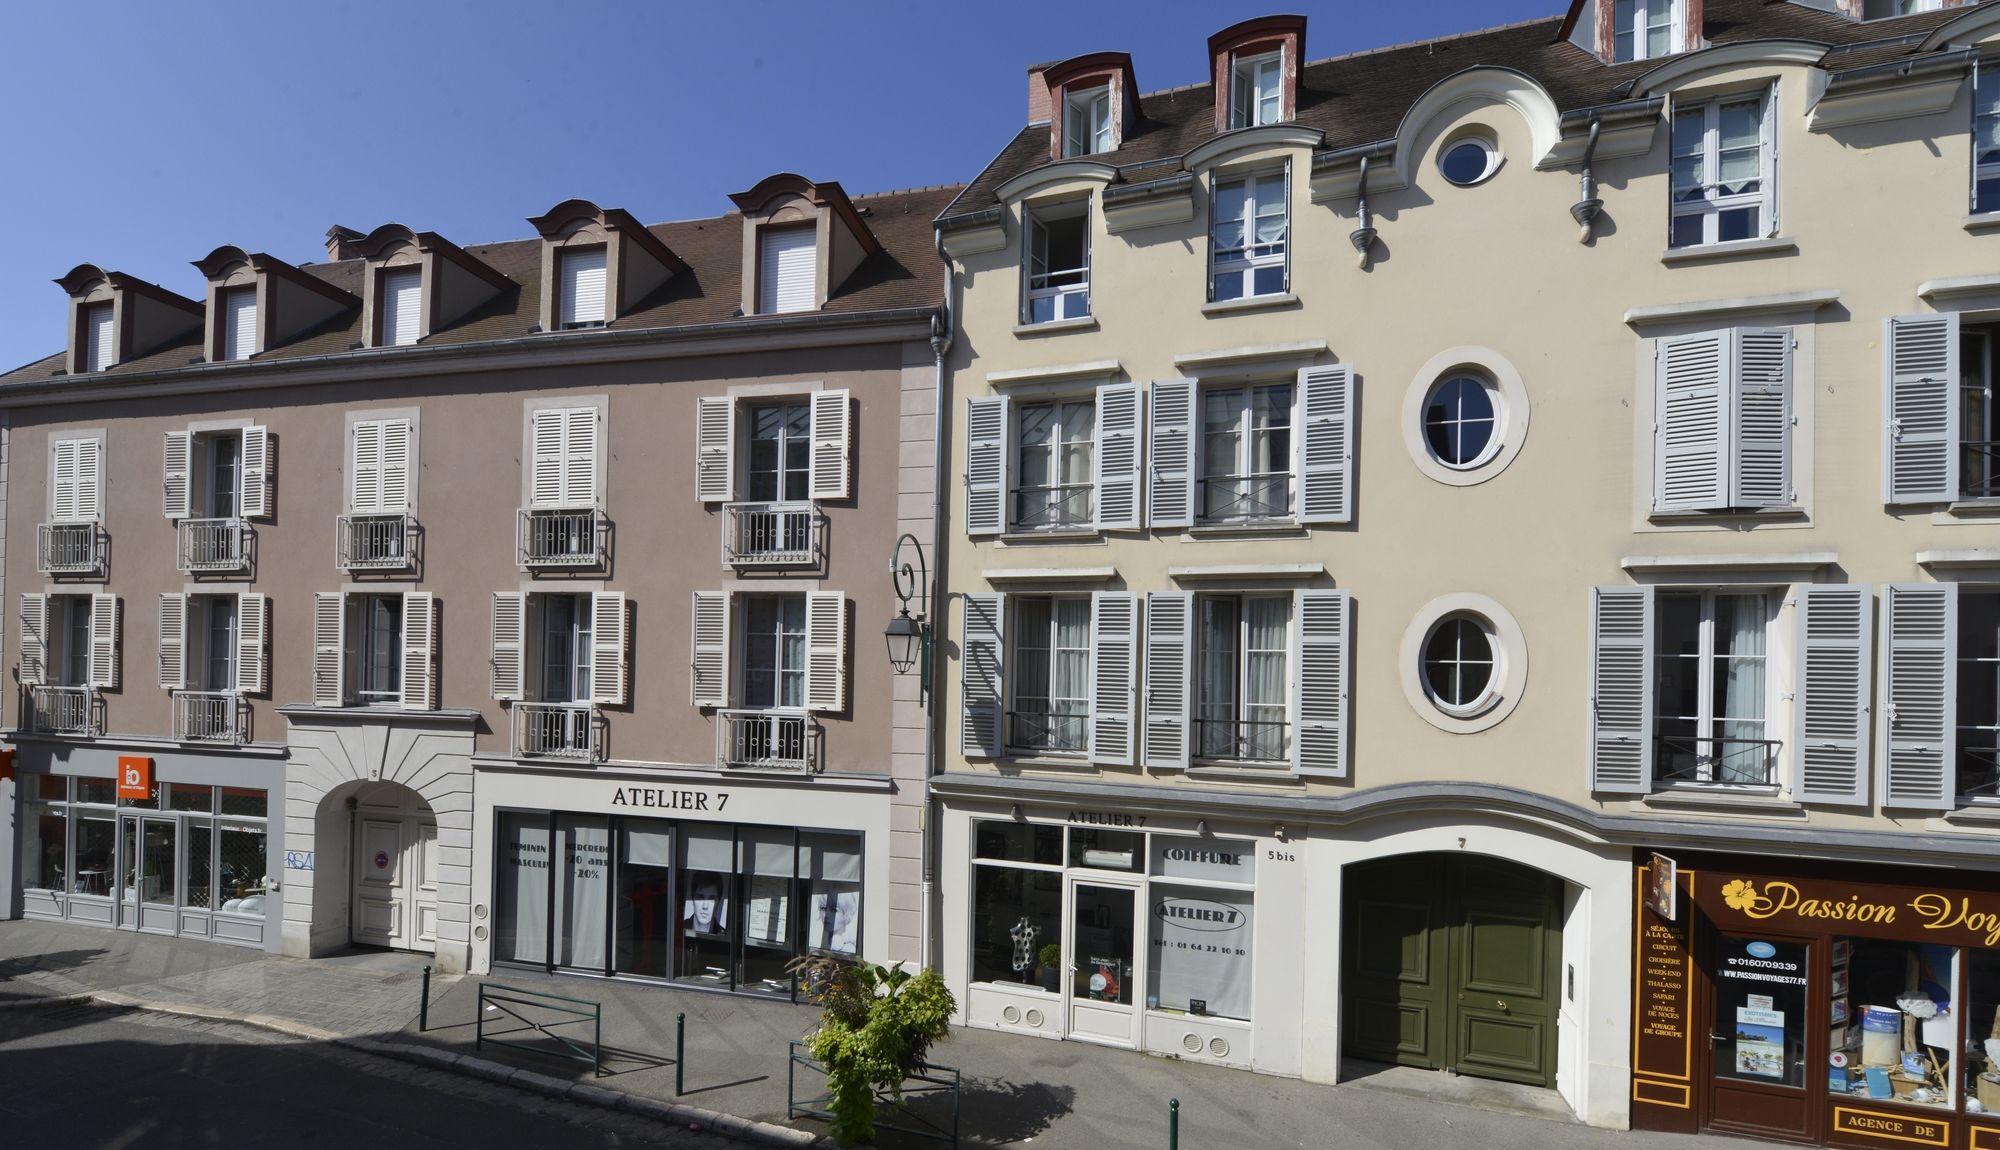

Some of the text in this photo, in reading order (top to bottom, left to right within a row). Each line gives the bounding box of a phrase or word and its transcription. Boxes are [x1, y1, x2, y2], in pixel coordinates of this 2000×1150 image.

[612, 787, 729, 811] ATELIER 7
[1067, 811, 1147, 828] ATELIER 7
[1458, 837, 1466, 849] 7
[1162, 848, 1241, 866] COIFFURE
[1745, 881, 1896, 924] Passion
[1159, 905, 1238, 923] ATELIER 7
[1647, 980, 1682, 989] THALASSO
[1652, 992, 1675, 1000] SAFARI
[1651, 1022, 1676, 1031] VOYAGE
[1655, 1030, 1683, 1038] GROUPE
[1848, 1116, 1935, 1137] AGENCE DE
